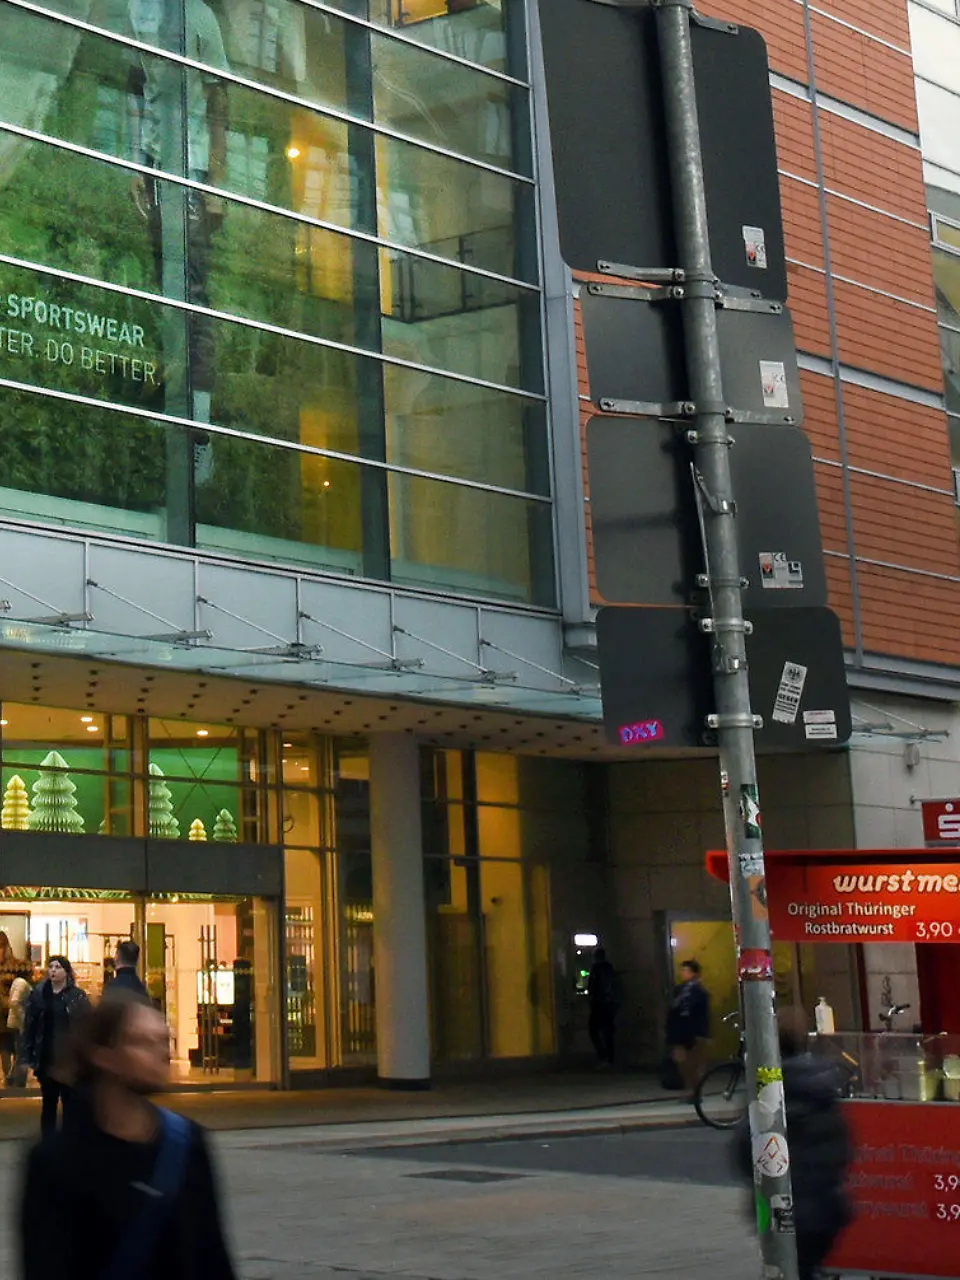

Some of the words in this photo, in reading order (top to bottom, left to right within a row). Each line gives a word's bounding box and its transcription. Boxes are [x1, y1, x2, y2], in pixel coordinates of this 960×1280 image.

[7, 294, 145, 348] SPORTSWEAR
[47, 338, 74, 366] DO
[81, 347, 161, 386] BETTER.
[833, 869, 960, 893] wurstme
[788, 902, 842, 918] Original
[846, 902, 916, 919] Thüringer
[805, 922, 894, 935] Rostbratwurst
[916, 922, 953, 939] 3,90
[934, 1174, 960, 1192] 3,9
[936, 1203, 960, 1220] 3,9
